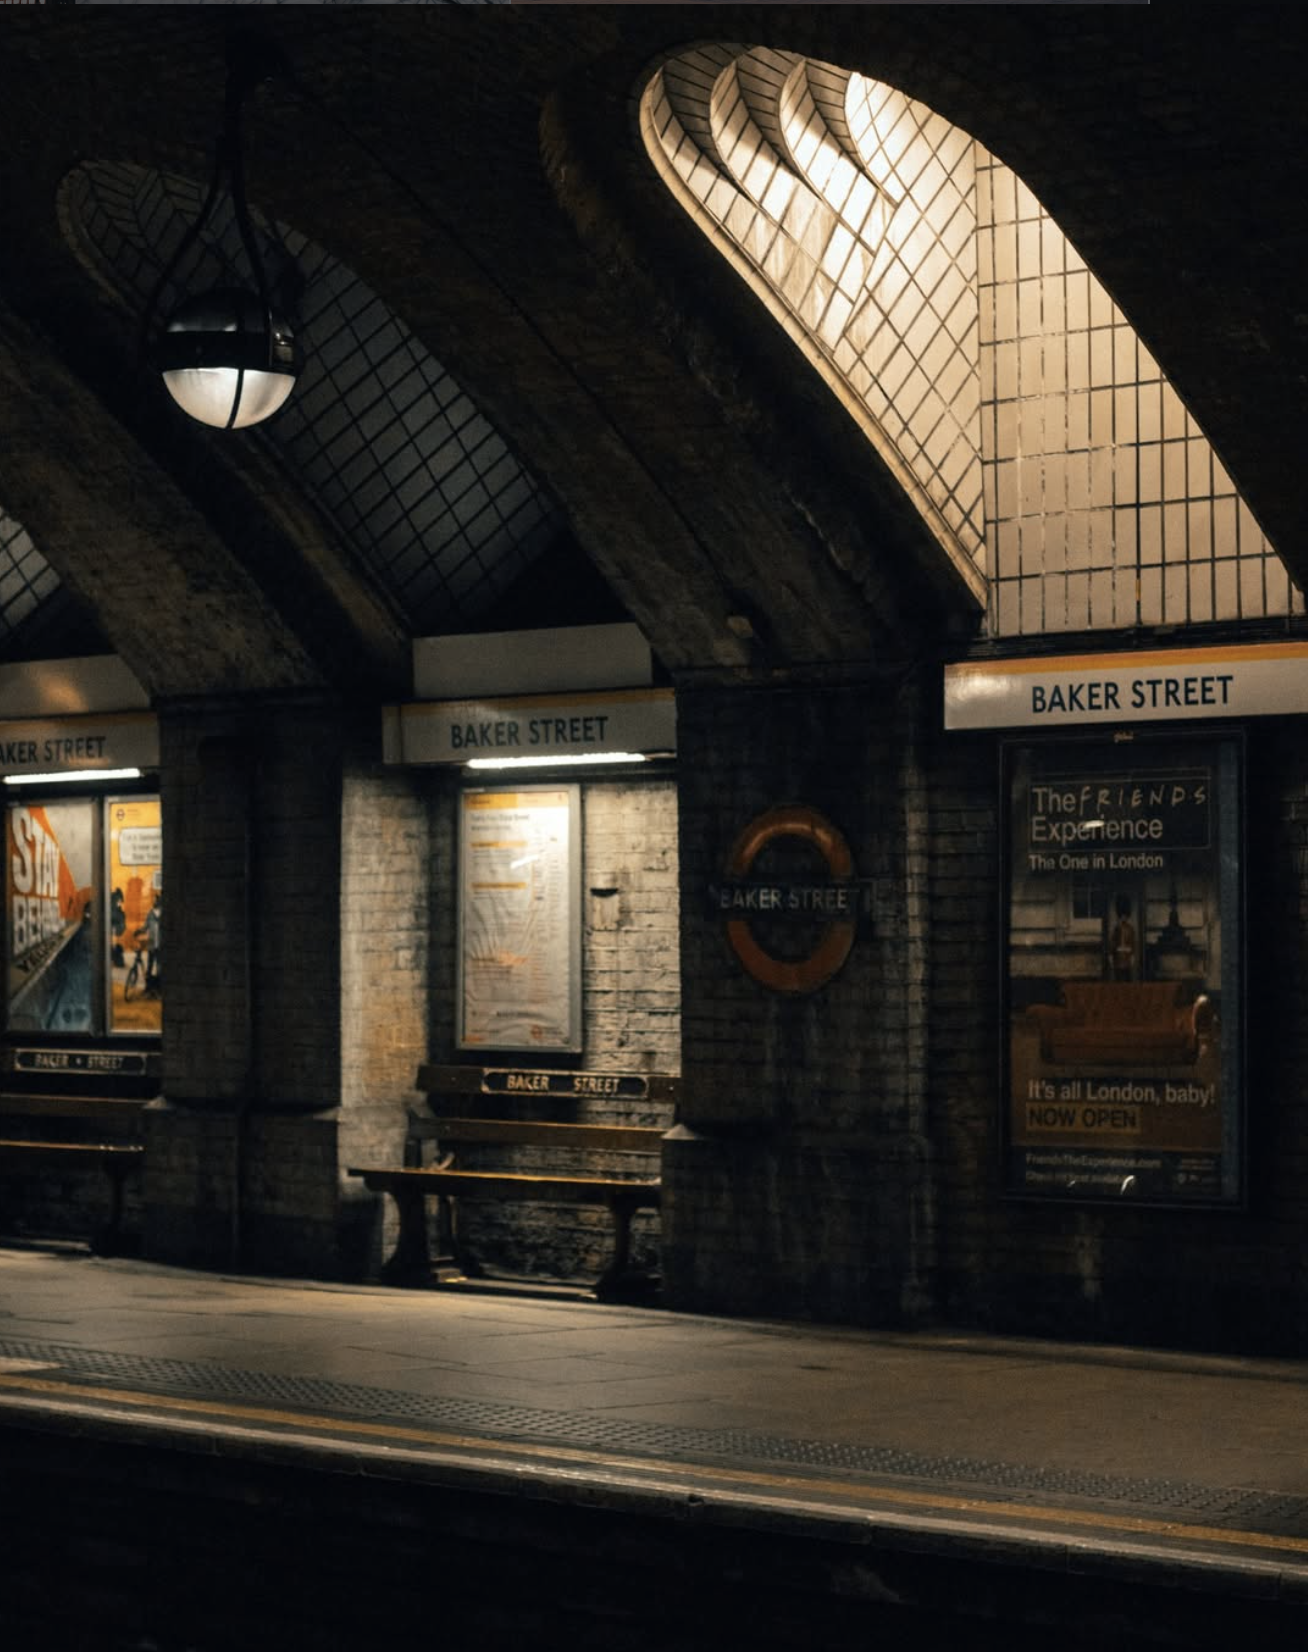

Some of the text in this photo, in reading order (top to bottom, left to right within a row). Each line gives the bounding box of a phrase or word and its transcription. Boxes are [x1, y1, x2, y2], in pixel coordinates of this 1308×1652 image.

[1032, 675, 1235, 714] BAKER STREET
[450, 716, 609, 748] BAKER STREET
[44, 736, 107, 763] STREET
[1031, 784, 1207, 815] The FRIENDS
[1030, 814, 1164, 847] Experience
[11, 806, 61, 898] STAY
[1028, 852, 1164, 871] The One in London
[506, 1073, 621, 1094] BAKER STREET
[1028, 1079, 1216, 1108] It's all London, baby!
[1028, 1107, 1137, 1128] NOW OPEN
